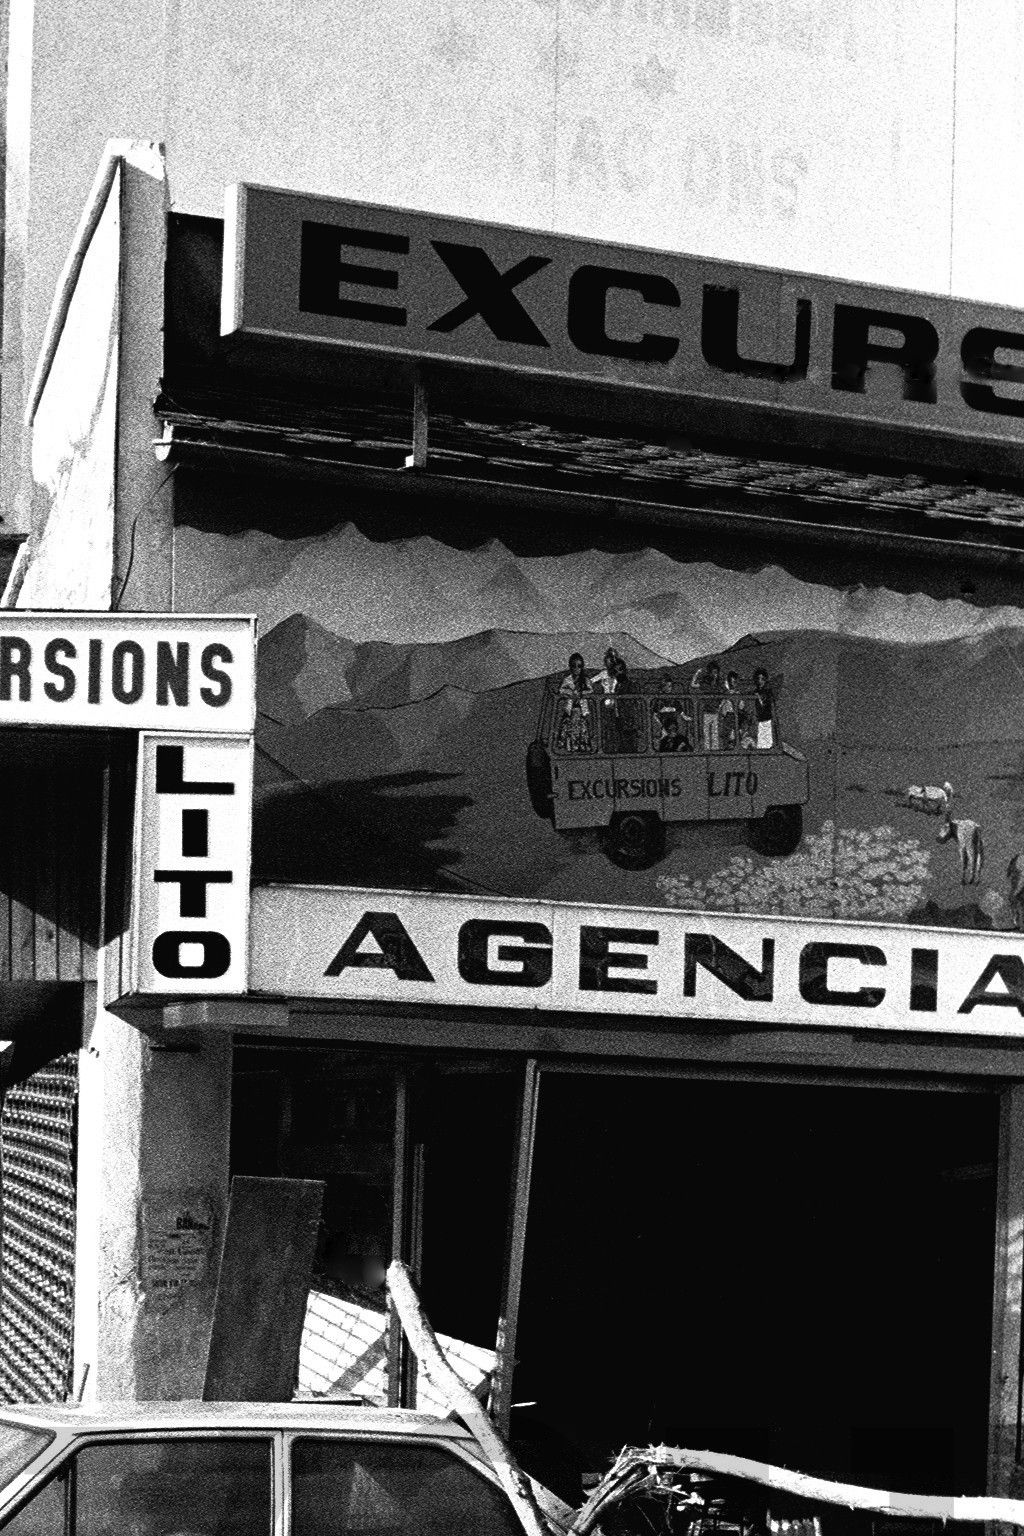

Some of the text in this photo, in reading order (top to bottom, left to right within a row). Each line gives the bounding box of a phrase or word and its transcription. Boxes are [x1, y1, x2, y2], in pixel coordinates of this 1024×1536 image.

[568, 771, 759, 800] EXCURSIONS LITO
[151, 744, 236, 980] LITO
[323, 911, 1024, 1016] AGENCIA
